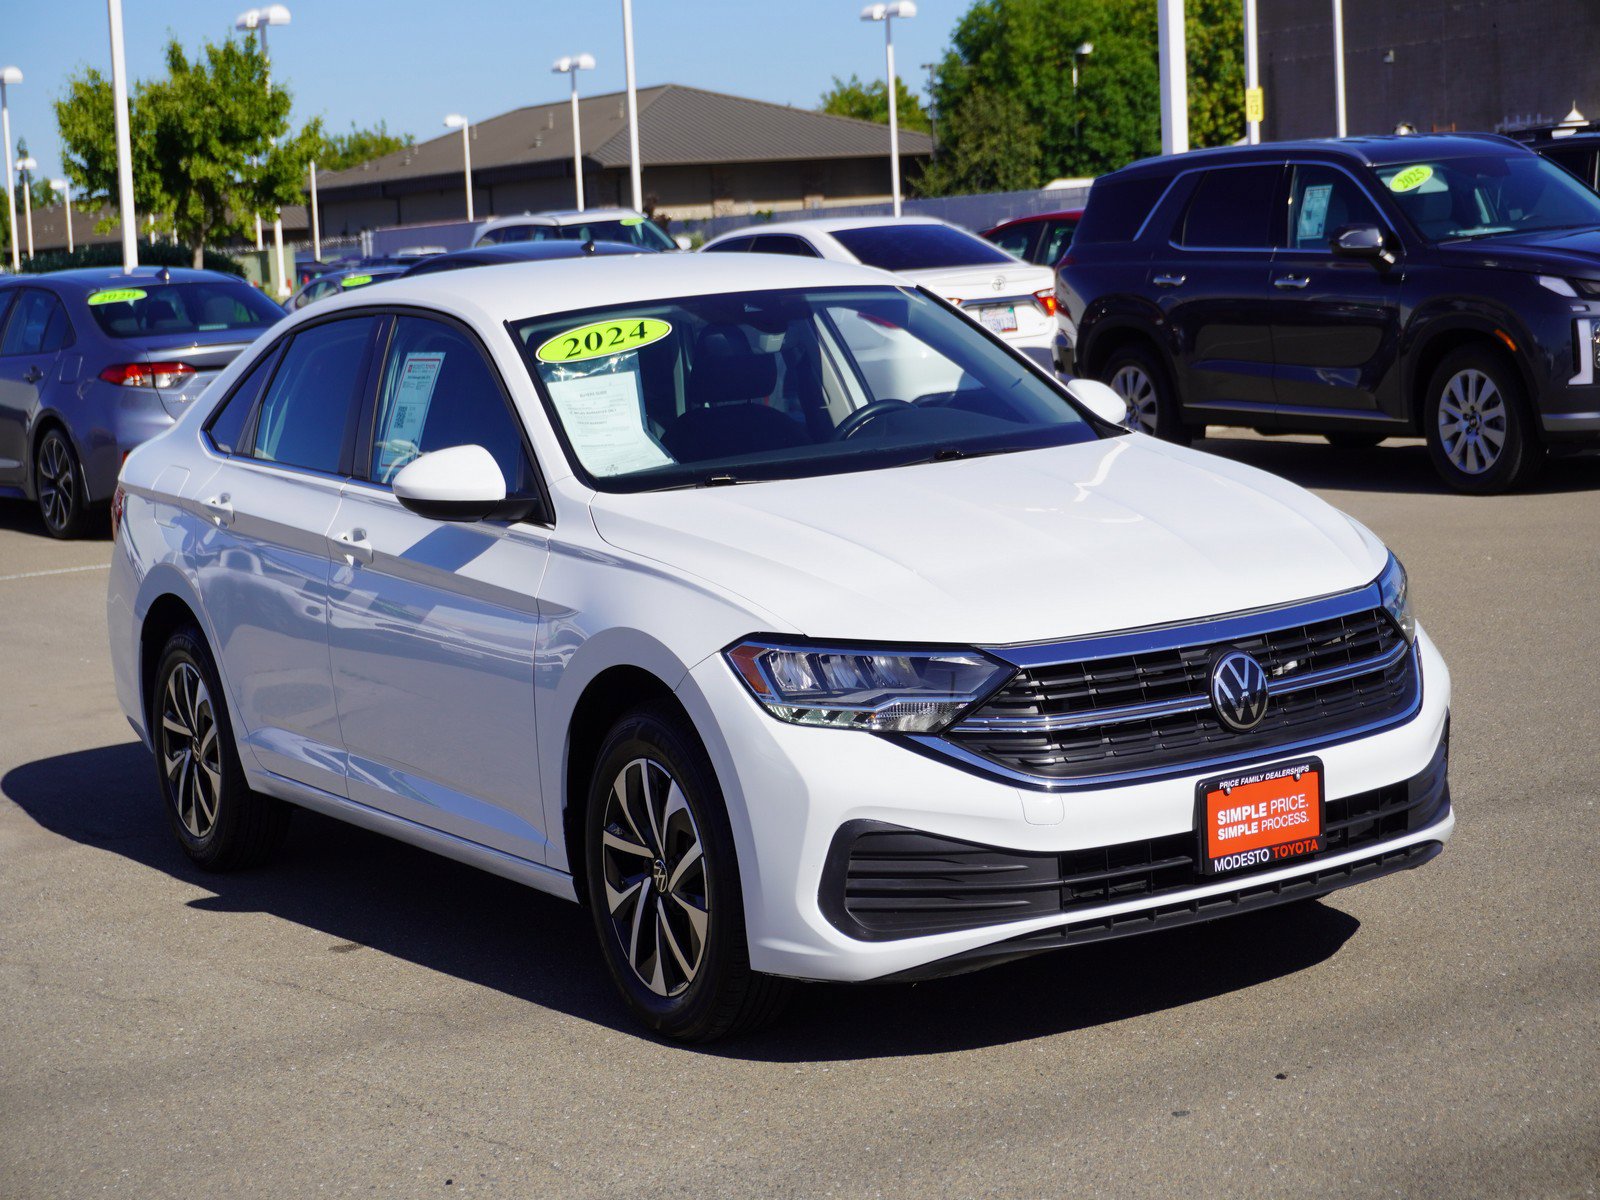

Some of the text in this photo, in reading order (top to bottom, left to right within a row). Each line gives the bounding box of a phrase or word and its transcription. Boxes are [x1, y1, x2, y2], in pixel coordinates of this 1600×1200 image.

[1397, 169, 1425, 189] 2025
[562, 321, 648, 360] 2024
[1219, 765, 1310, 789] PRICE FAMILY DEALERSHIPS
[1217, 794, 1309, 825] SIMPLE PRICE.
[1217, 812, 1309, 841] SIMPLE PROCESS.
[1214, 839, 1319, 872] MODESTO TOYOTA
